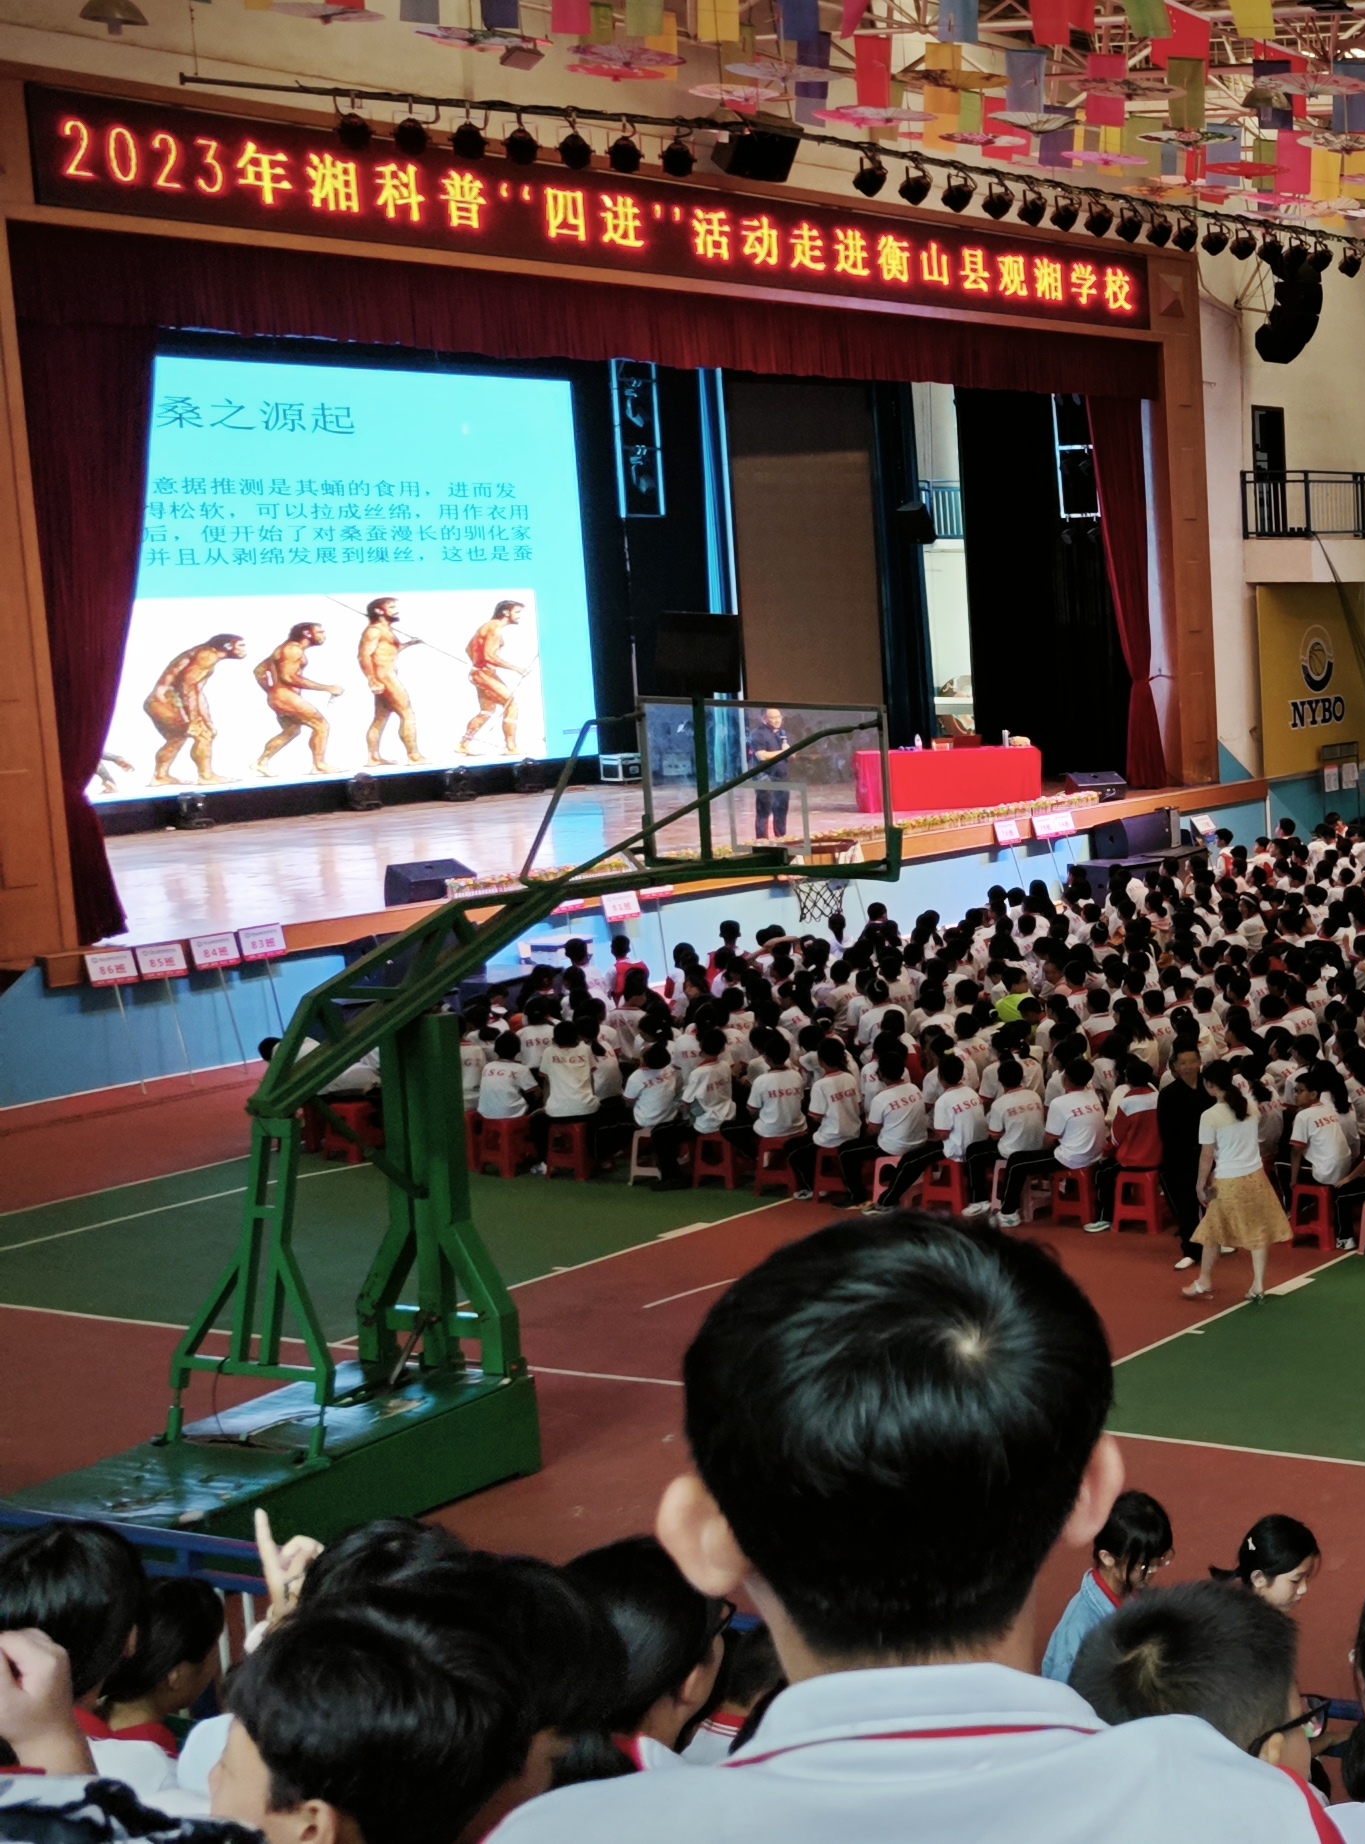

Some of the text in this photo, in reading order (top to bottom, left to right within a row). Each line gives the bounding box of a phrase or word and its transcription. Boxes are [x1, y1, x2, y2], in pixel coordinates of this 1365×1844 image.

[157, 395, 355, 434] 桑之源起
[1290, 695, 1345, 730] NYBO
[768, 1087, 801, 1098] HSGX
[1071, 1104, 1100, 1118] HSG
